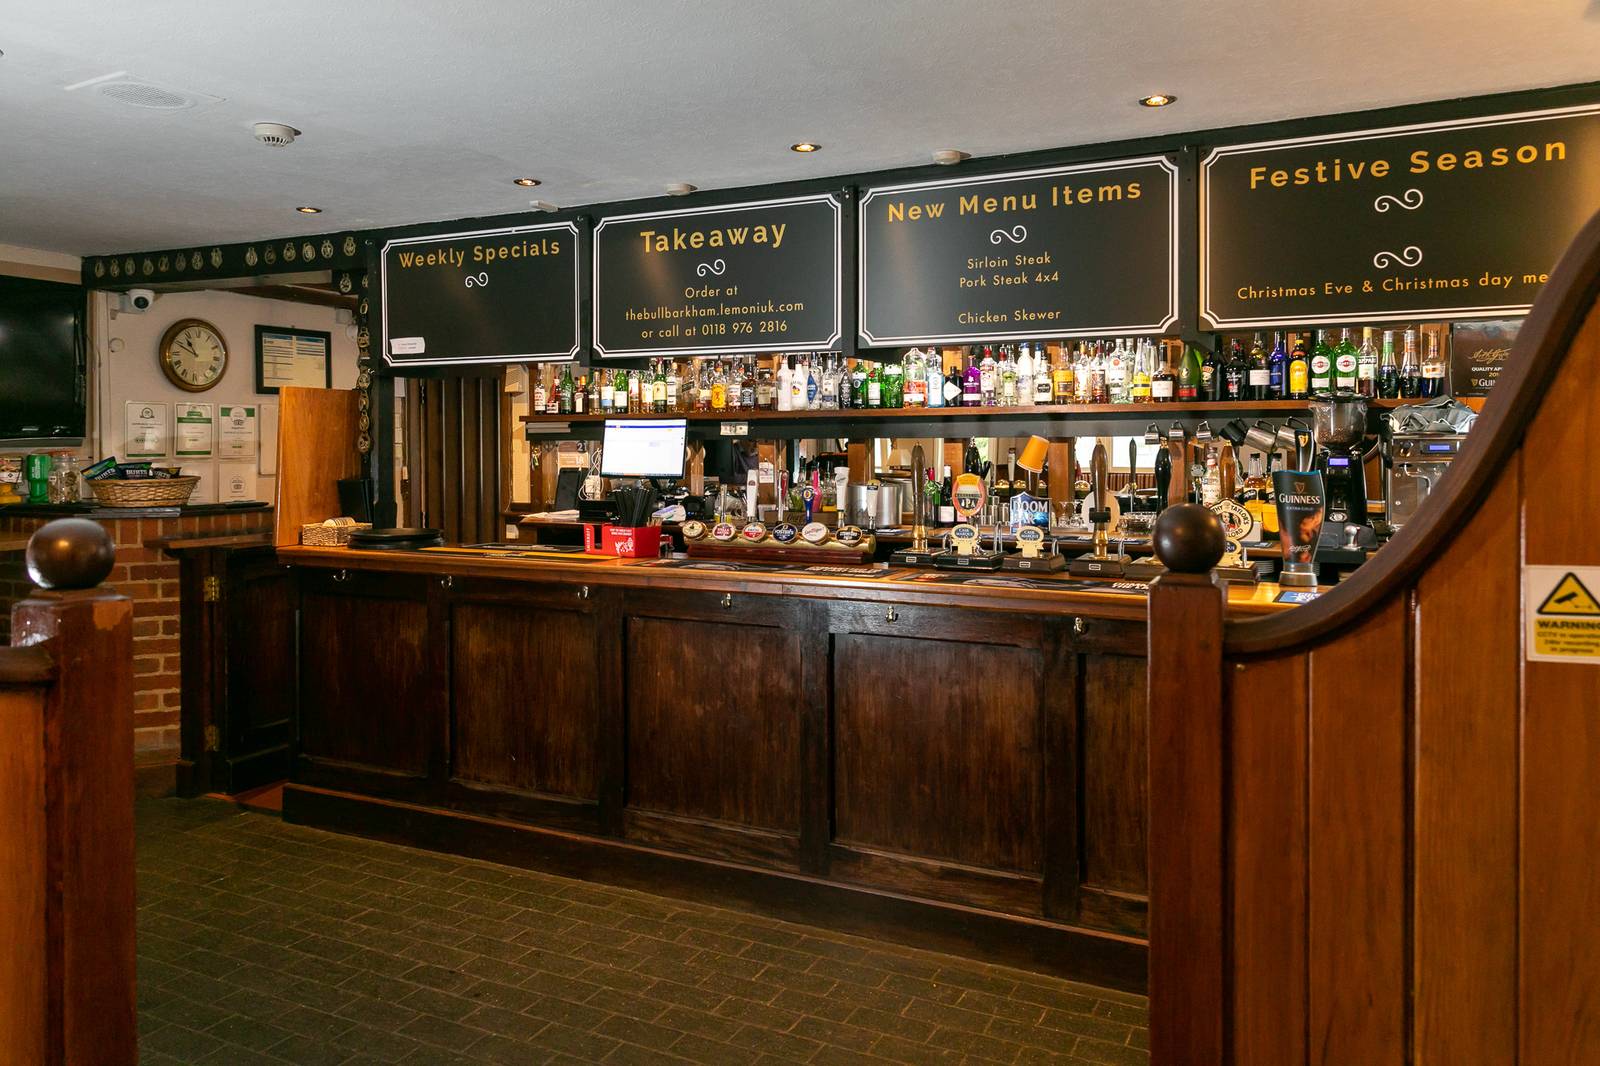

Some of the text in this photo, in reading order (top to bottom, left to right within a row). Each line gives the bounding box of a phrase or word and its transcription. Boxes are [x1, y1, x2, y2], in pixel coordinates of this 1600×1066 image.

[1249, 141, 1567, 190] Festive Season
[887, 182, 1142, 225] New Menu Items
[639, 223, 787, 255] Takeaway
[398, 239, 561, 270] Weekly Specials
[967, 251, 1051, 269] Sirloin Steak
[958, 271, 1059, 288] Pork Steak 4x4
[1236, 271, 1549, 301] Christmas Eve & Christmas day me
[684, 285, 738, 299] Order at
[625, 300, 805, 321] thebullbarkham.lemoniuk.com
[957, 308, 1061, 325] Chicken Skewer
[641, 320, 788, 338] or call at 0118 976 2816
[1478, 378, 1496, 387] GUI
[961, 499, 976, 508] IPA
[1012, 500, 1048, 513] DOOM
[1279, 493, 1321, 505] GUINNESS
[1013, 512, 1035, 524] BAR
[1230, 504, 1250, 526] TAYLOR'S
